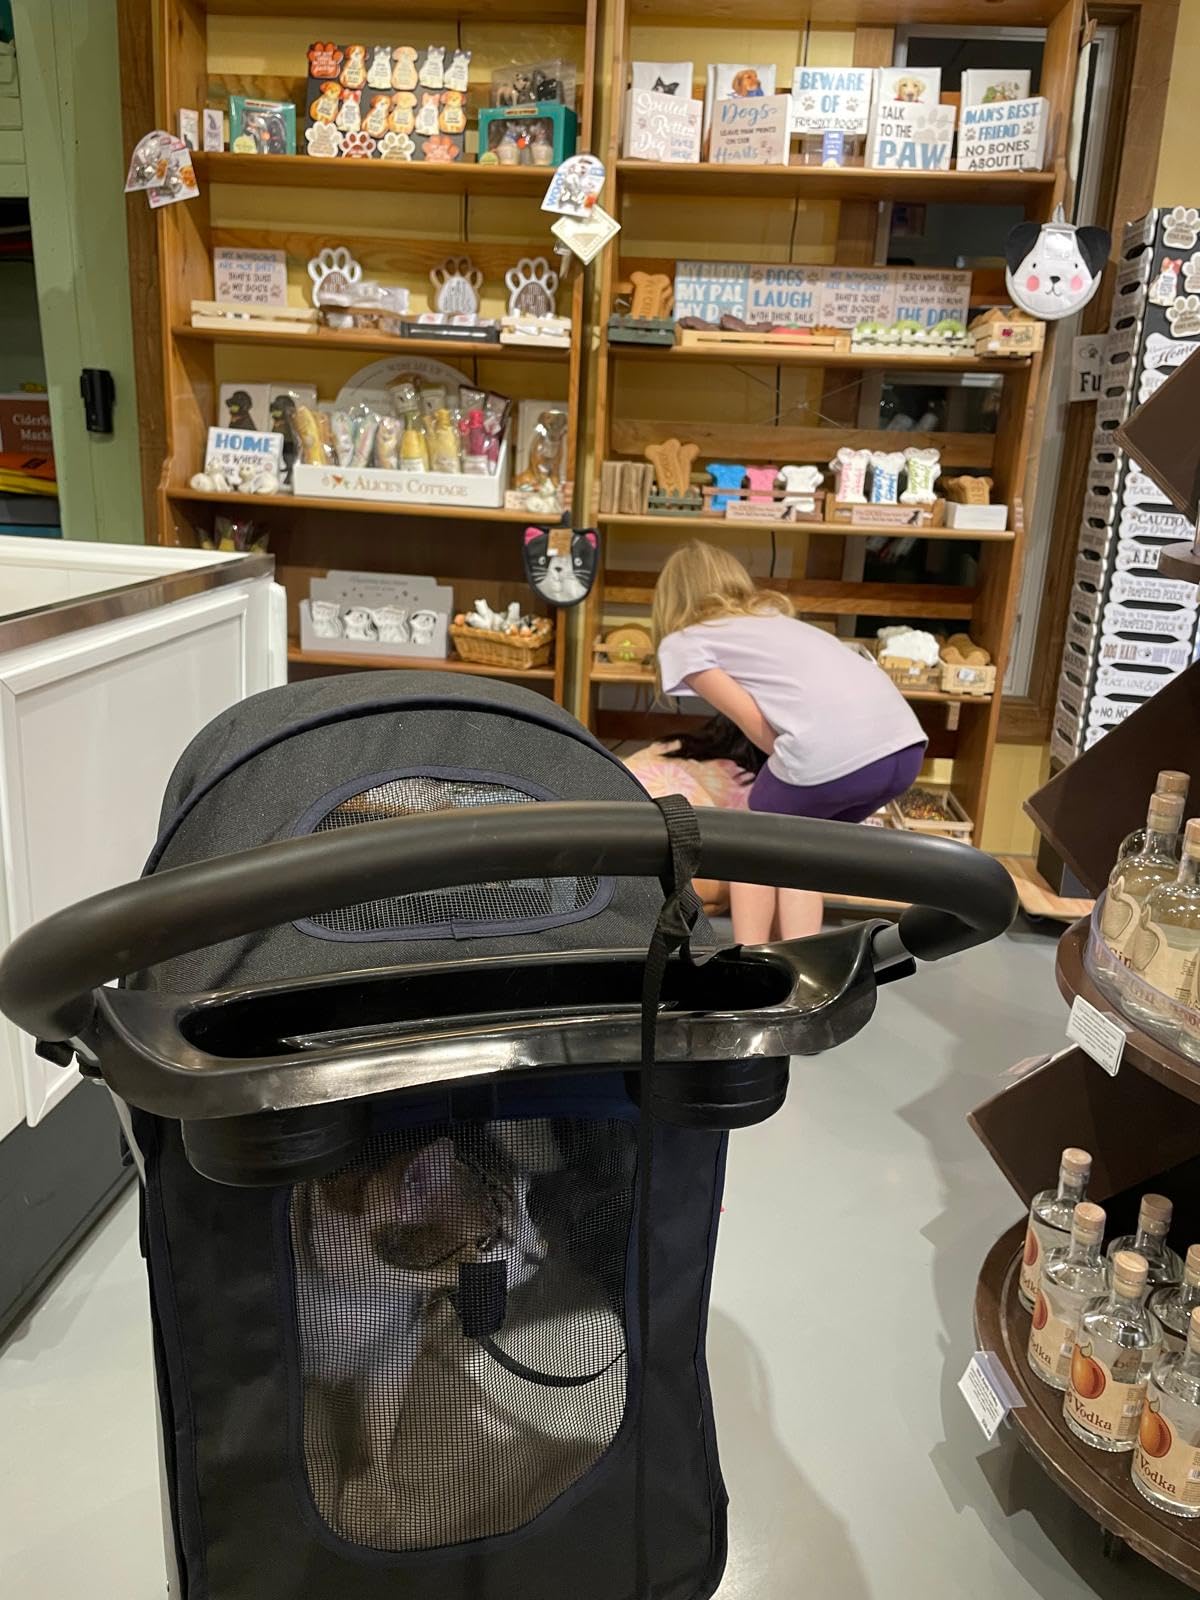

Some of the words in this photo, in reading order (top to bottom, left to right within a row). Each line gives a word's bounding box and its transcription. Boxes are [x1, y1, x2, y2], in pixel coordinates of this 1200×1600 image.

[800, 71, 865, 91] BEWARE
[820, 95, 840, 113] OF
[881, 106, 905, 120] TALK
[965, 107, 1004, 125] MAN'S
[1006, 102, 1039, 120] BEST
[720, 103, 772, 126] Dogs
[794, 117, 831, 129] FRIENDLY
[833, 118, 865, 130] POOCH
[880, 123, 893, 136] TO
[895, 124, 912, 138] THE
[978, 123, 1020, 141] FRIEND
[877, 140, 948, 169] PAW
[965, 145, 985, 157] NO
[987, 140, 1031, 155] BONES
[968, 155, 1011, 170] ABOUT
[1012, 153, 1024, 167] IT
[680, 263, 700, 282] MY
[704, 264, 745, 283] BUDDY
[766, 269, 803, 287] DOGS
[678, 283, 705, 302] MY
[708, 284, 745, 303] PAL
[752, 290, 812, 308] LAUGH
[705, 303, 745, 325] DG
[896, 306, 922, 322] THE
[927, 308, 964, 327] DOG!
[215, 433, 274, 453] HOME
[233, 455, 262, 465] WHERE
[353, 477, 403, 492] ALICE'S
[407, 479, 468, 497] COTTAGE
[1136, 513, 1190, 528] CAUTIO
[1074, 1395, 1113, 1431] Vodka
[1139, 1452, 1177, 1494] Vodka
